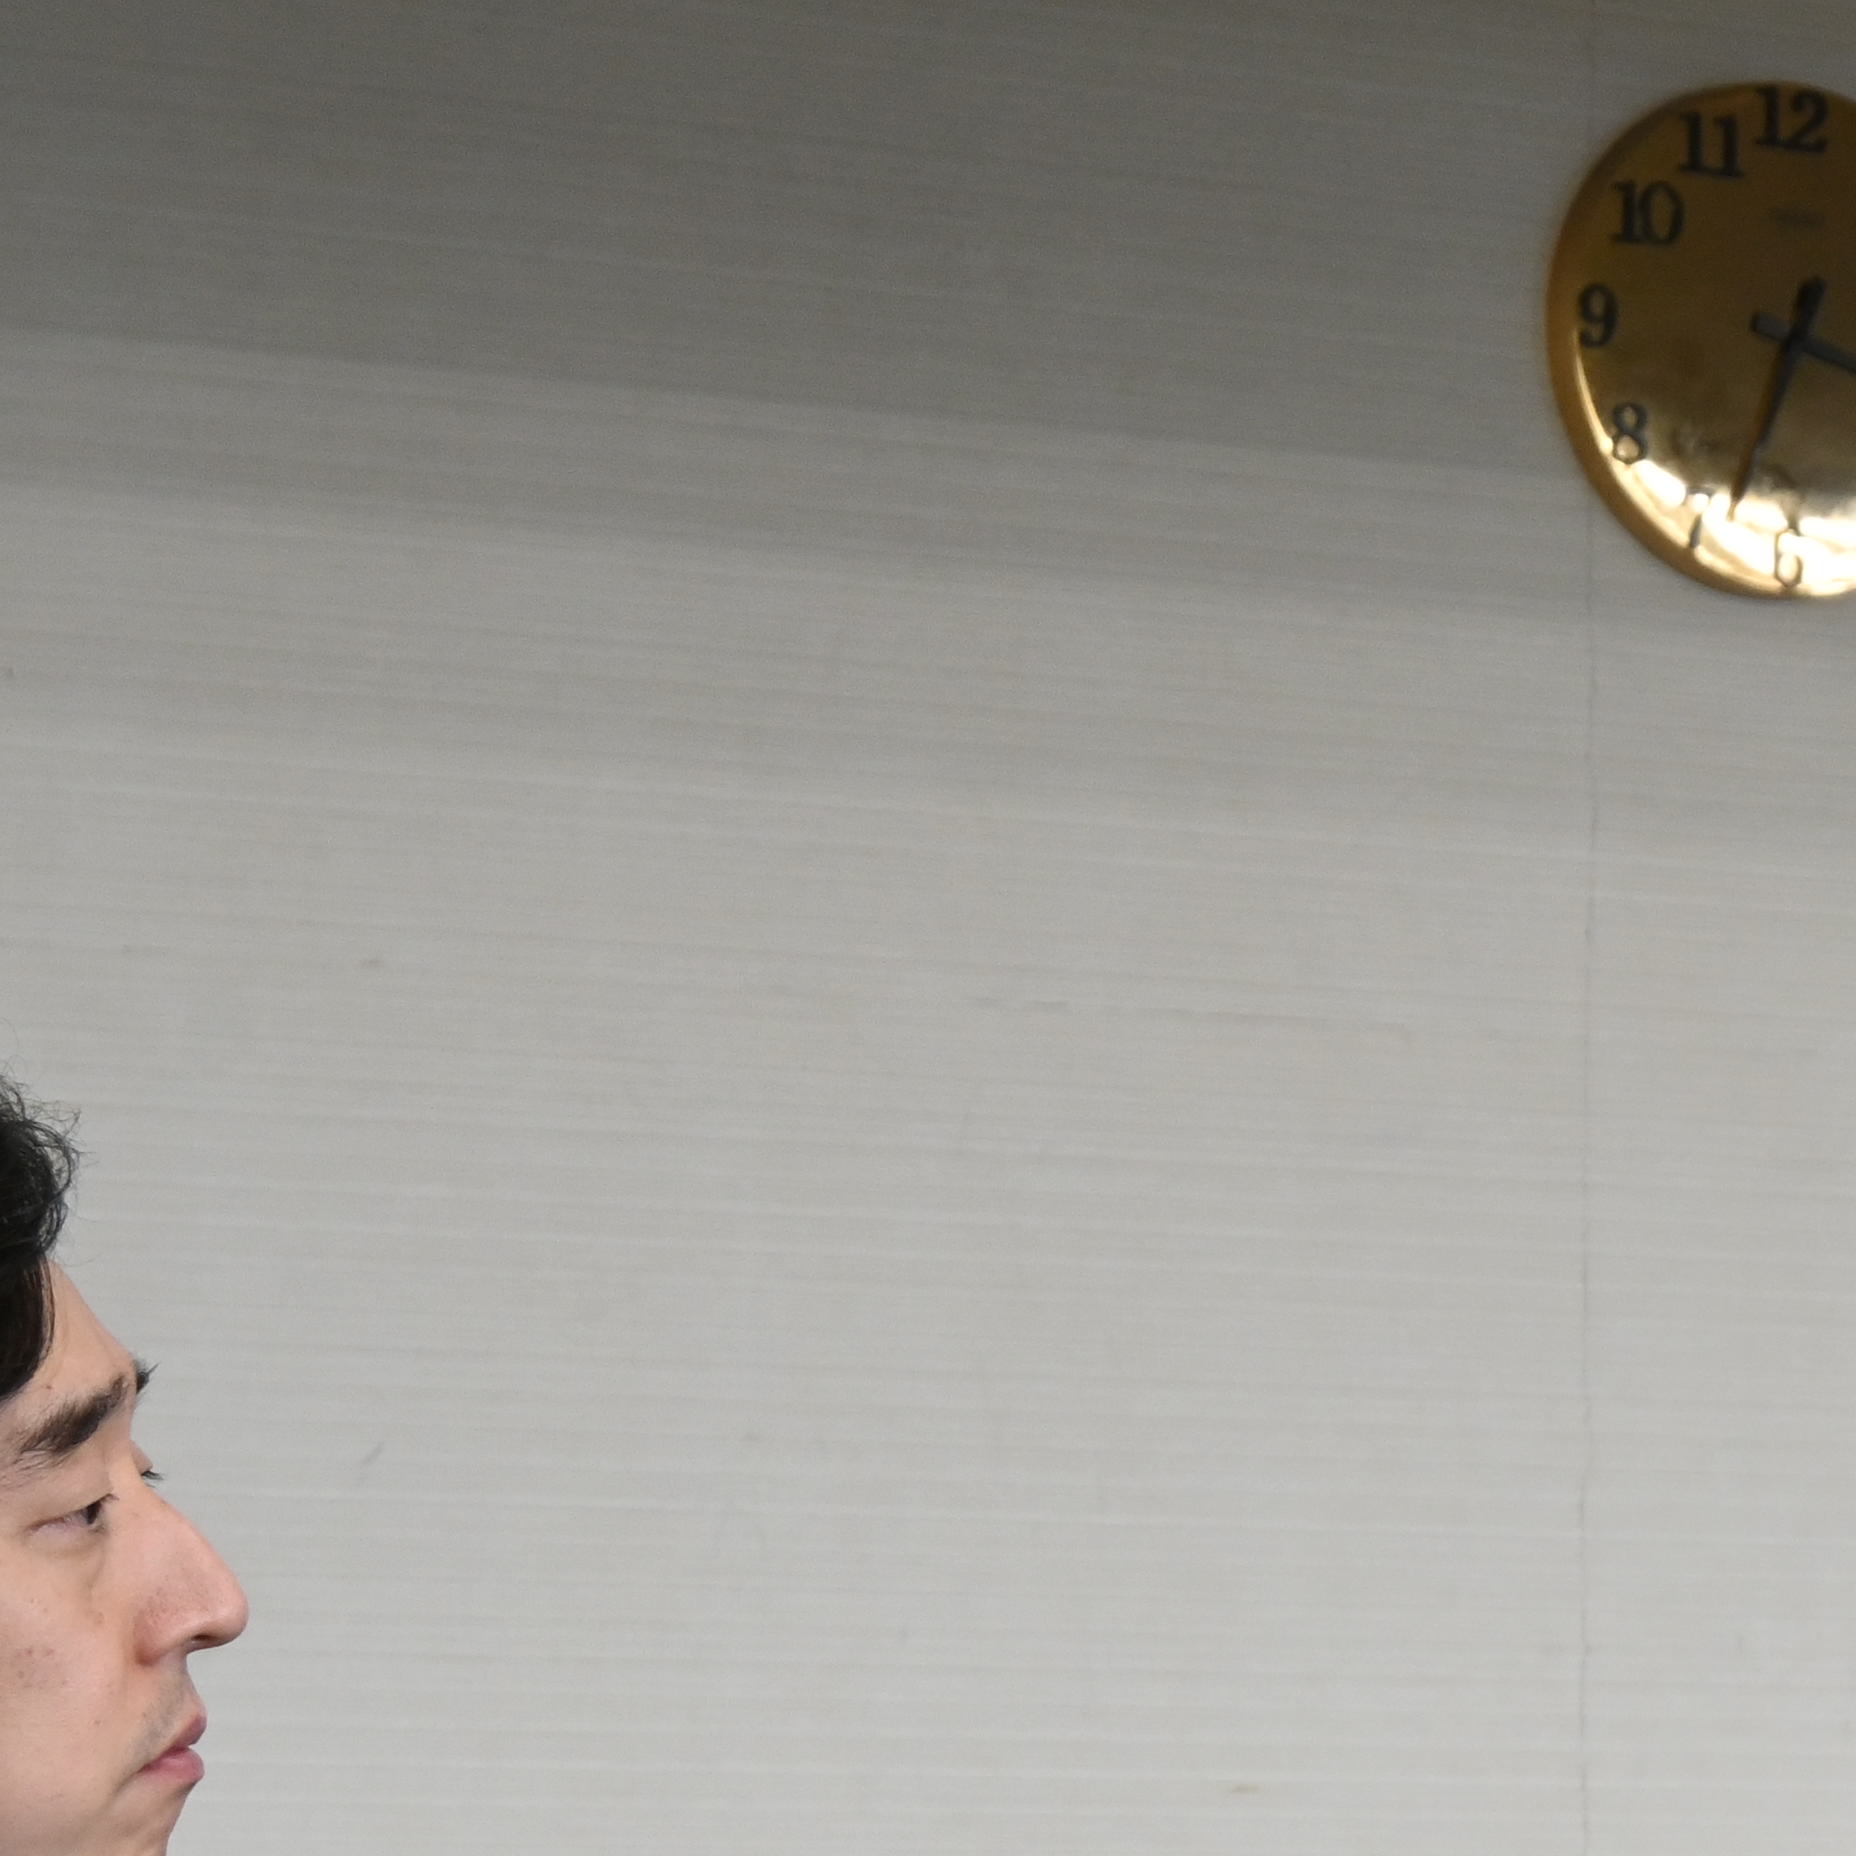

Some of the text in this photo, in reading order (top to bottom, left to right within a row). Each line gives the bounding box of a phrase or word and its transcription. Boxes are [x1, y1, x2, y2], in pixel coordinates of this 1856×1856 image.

[1678, 111, 1745, 179] 11
[1754, 84, 1829, 153] 12
[1611, 180, 1685, 246] 10
[1577, 283, 1618, 349] 9
[1611, 402, 1648, 464] 8
